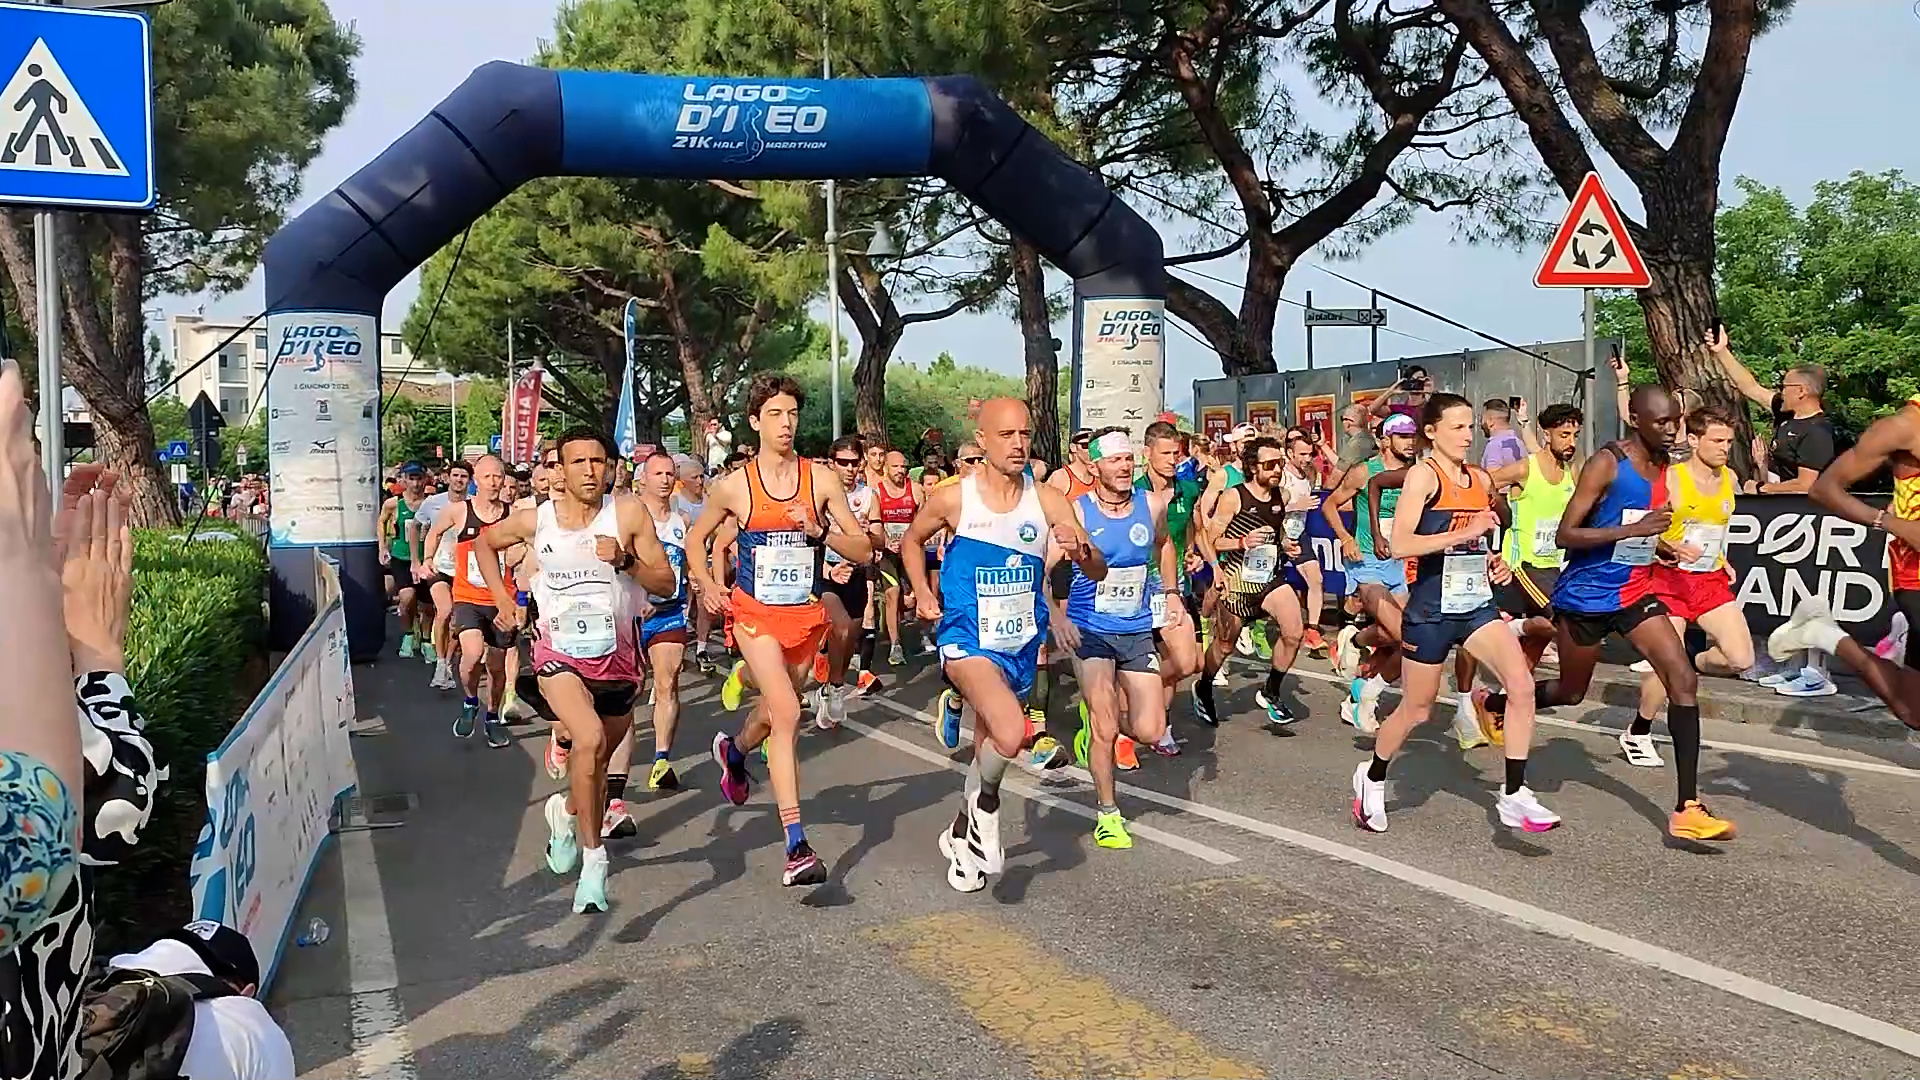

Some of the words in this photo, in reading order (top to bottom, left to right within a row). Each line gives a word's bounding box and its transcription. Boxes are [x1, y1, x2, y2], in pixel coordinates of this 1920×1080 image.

[683, 84, 787, 102] LAGO
[672, 136, 714, 149] 21K
[712, 141, 744, 149] HALF
[765, 141, 827, 149] MARATHON
[1103, 311, 1151, 321] LAGO
[283, 326, 342, 338] LAGO
[1256, 559, 1268, 569] 56
[771, 568, 799, 582] 766
[978, 567, 1031, 585] main
[1466, 577, 1474, 592] 8
[576, 619, 588, 635] 9
[995, 617, 1024, 635] 408
